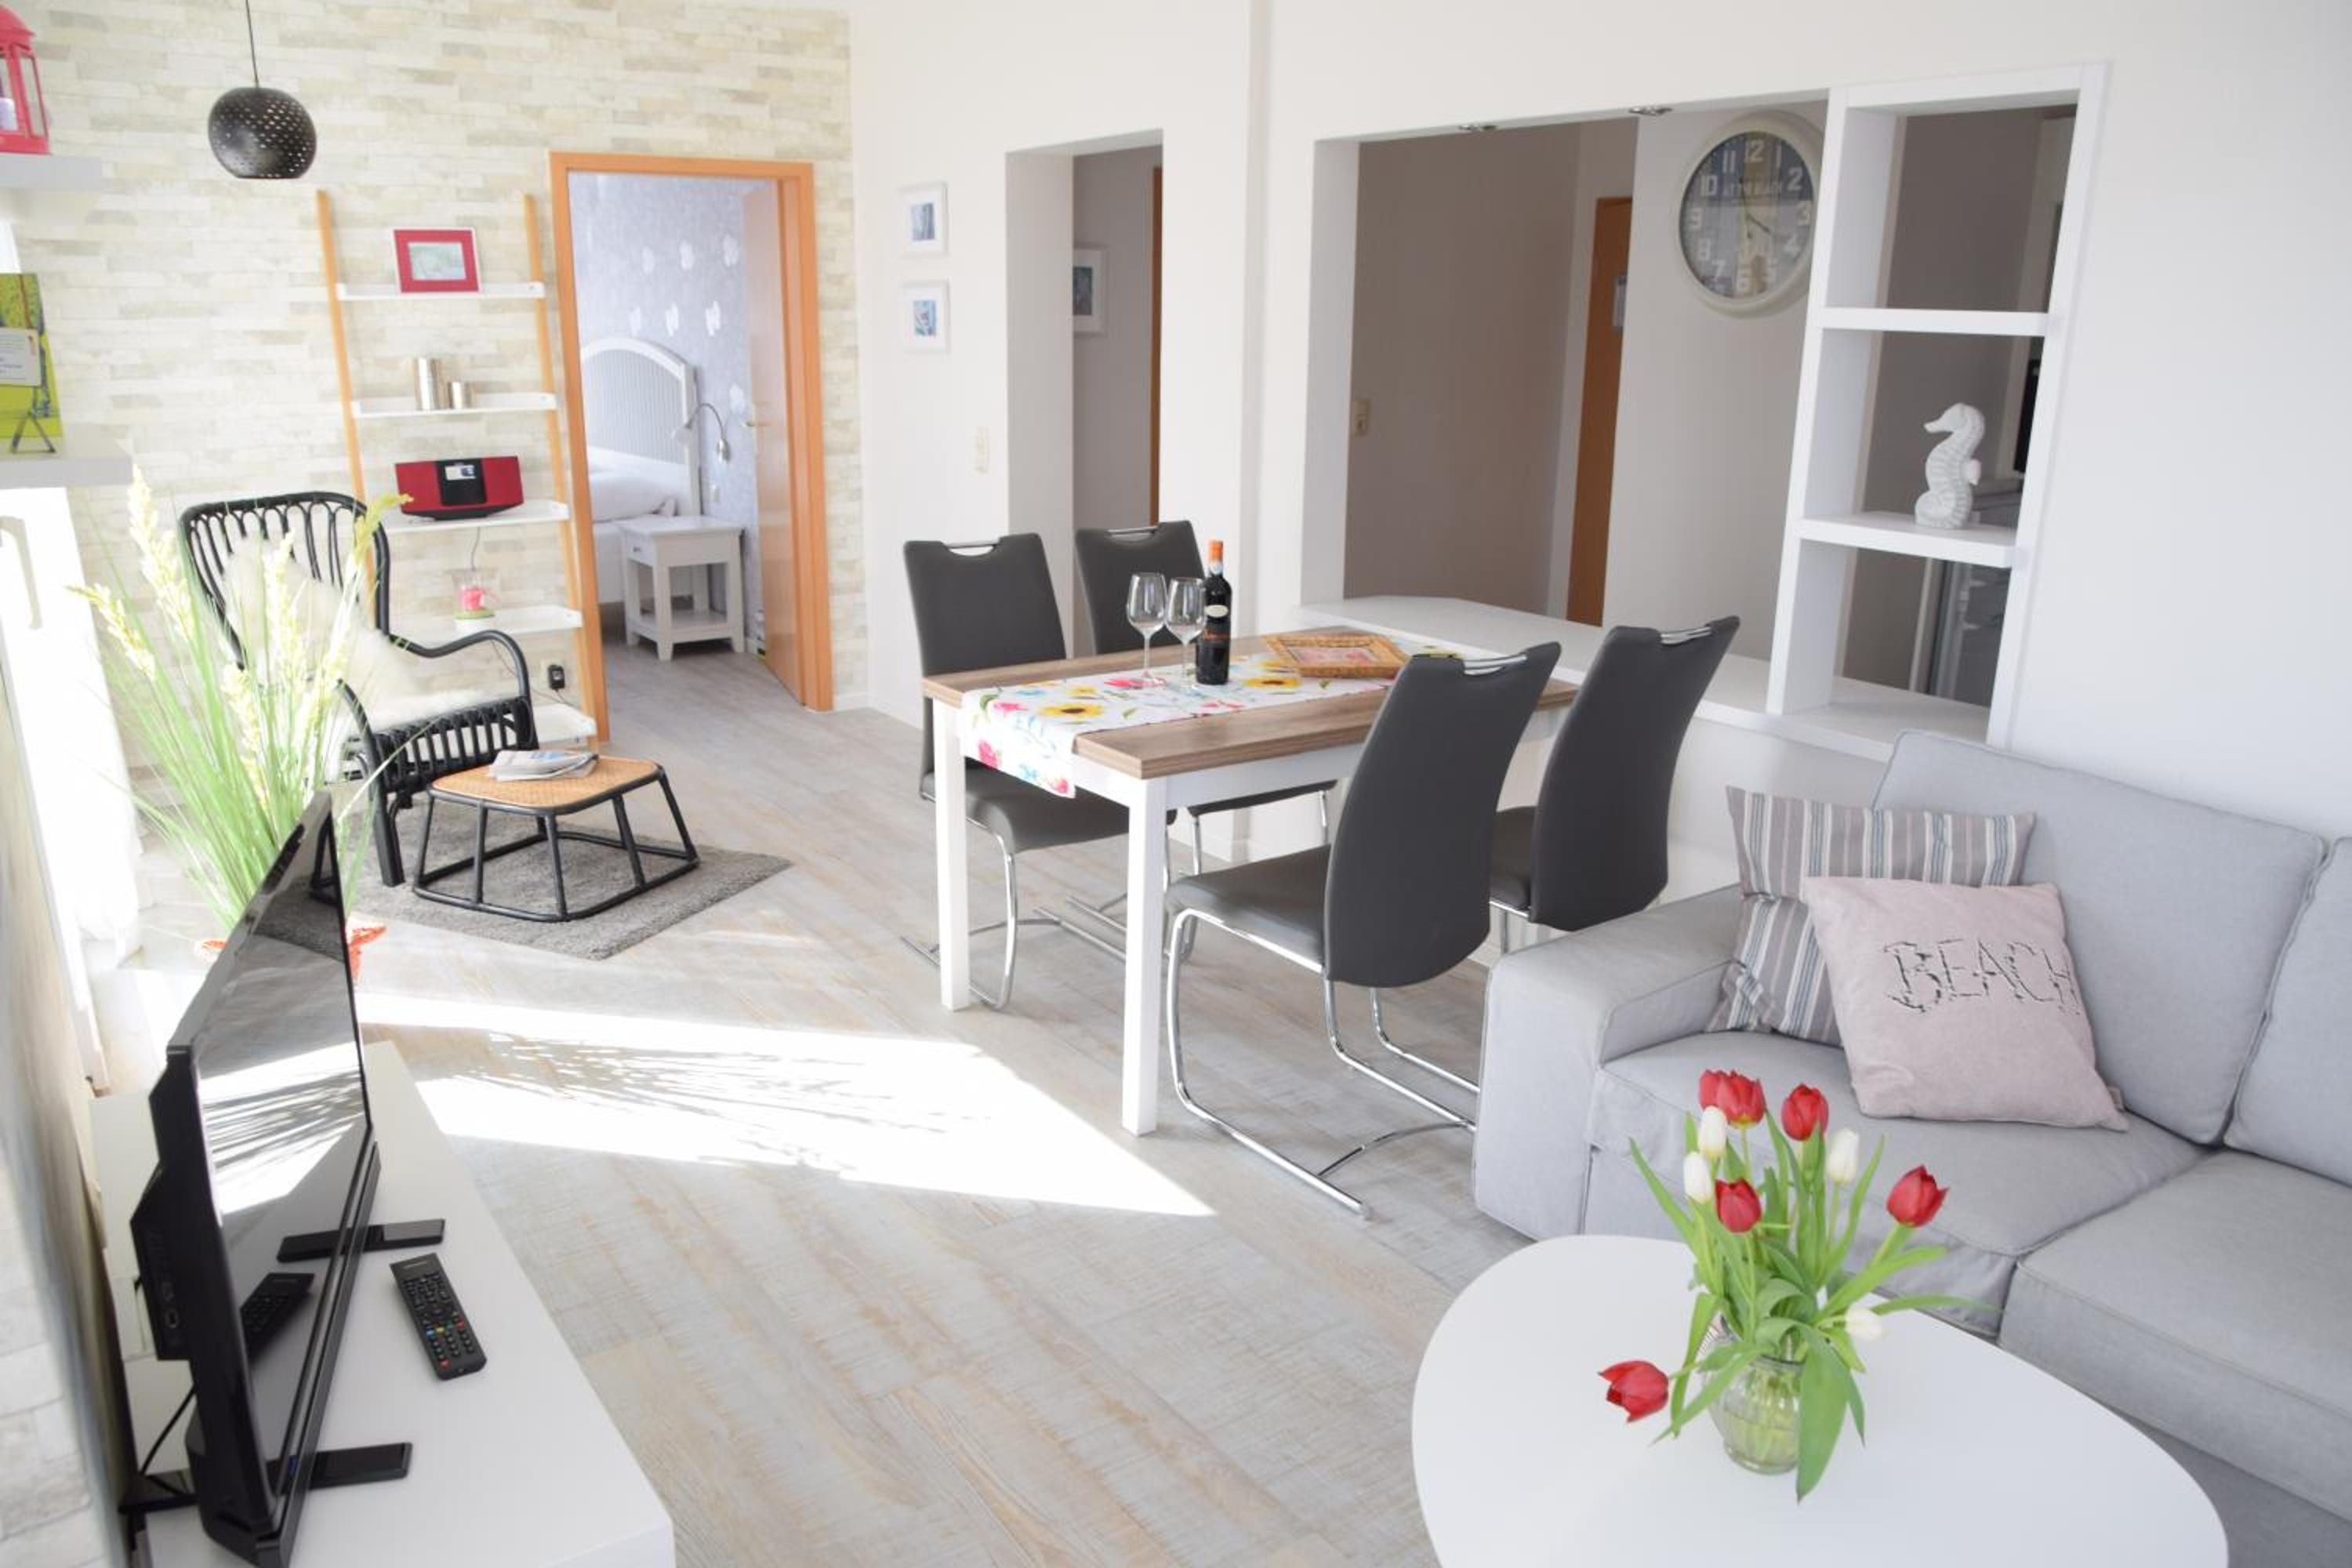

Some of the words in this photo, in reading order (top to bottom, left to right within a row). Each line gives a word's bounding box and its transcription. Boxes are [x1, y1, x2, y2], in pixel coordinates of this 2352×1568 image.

[1722, 150, 1737, 174] 11
[1744, 140, 1764, 163] 12
[1700, 174, 1718, 197] 10
[1788, 167, 1802, 191] 2
[1689, 208, 1704, 230] 9
[1798, 201, 1812, 226] 3
[1699, 238, 1711, 261] 8
[1784, 234, 1801, 256] 4
[1711, 260, 1726, 281] 7
[1736, 267, 1751, 292] 6
